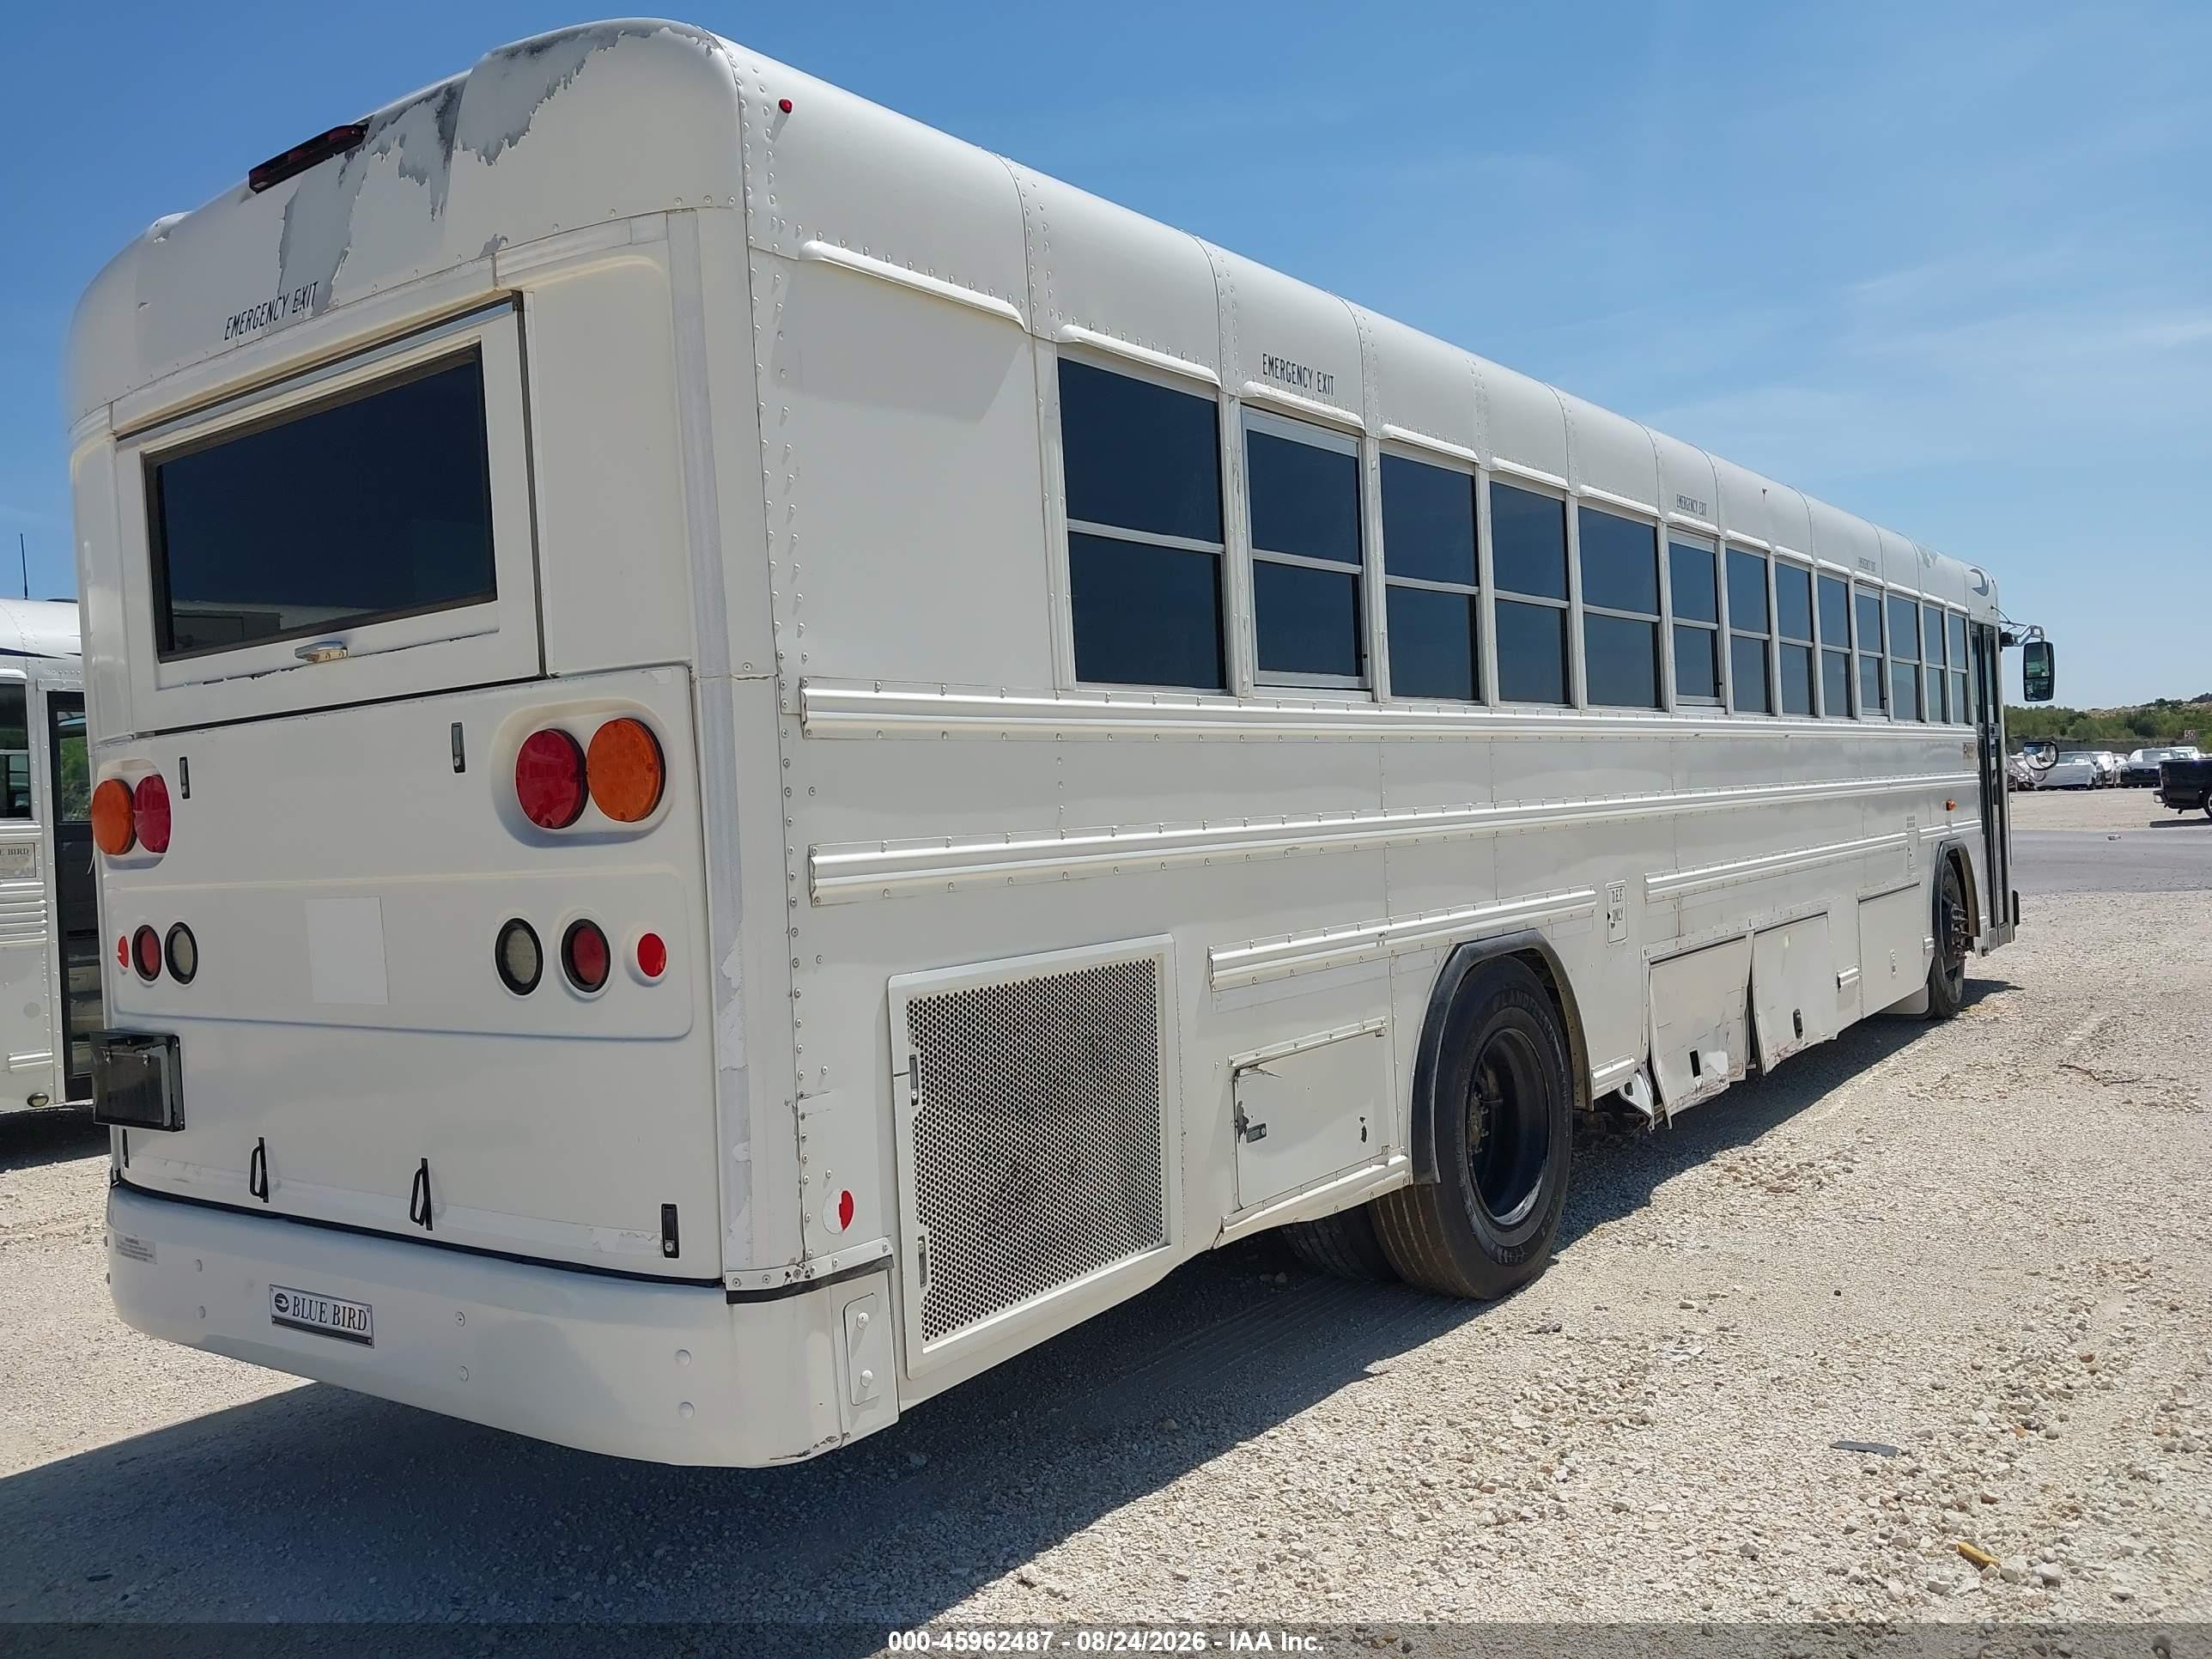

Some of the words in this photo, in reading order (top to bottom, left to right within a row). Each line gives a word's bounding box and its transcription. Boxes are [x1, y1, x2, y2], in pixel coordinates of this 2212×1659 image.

[224, 293, 290, 341] EMERGENCY
[292, 281, 319, 313] EXIT
[1262, 353, 1314, 389] EMERGENCY
[1316, 371, 1334, 396] EXIT
[8, 848, 29, 856] BIRD
[1612, 907, 1624, 922] ONLY
[292, 1296, 328, 1323] BLUE
[332, 1304, 368, 1331] BIRD
